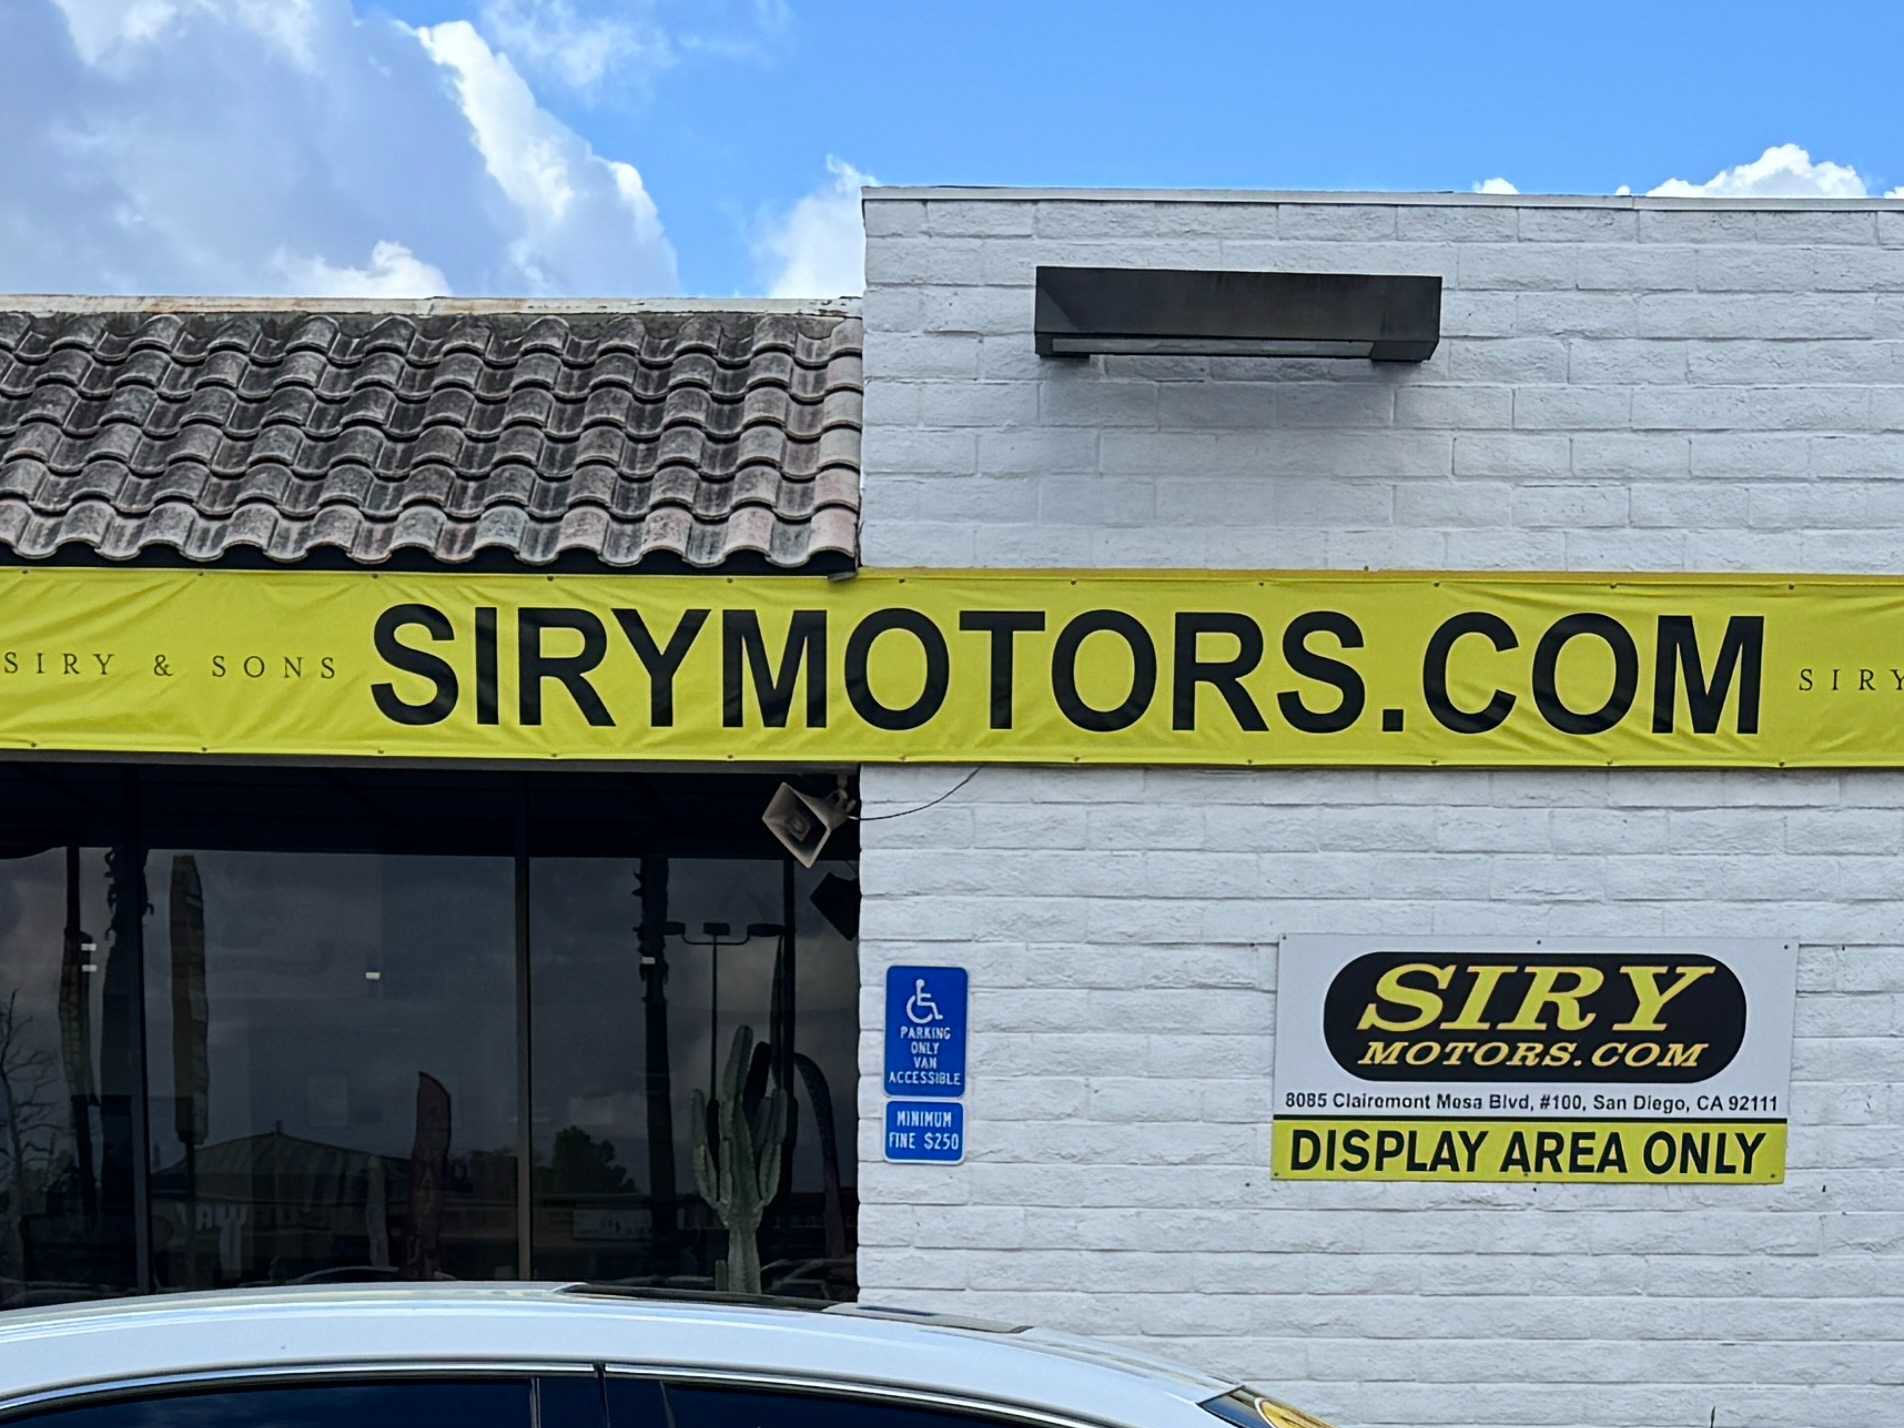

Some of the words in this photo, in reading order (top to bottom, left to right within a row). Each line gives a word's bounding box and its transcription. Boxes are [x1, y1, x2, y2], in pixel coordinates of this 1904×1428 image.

[4, 651, 114, 676] SIRY
[152, 653, 174, 677] &
[211, 655, 338, 680] SONS
[371, 603, 1766, 736] SIRYMOTORS.COM
[1356, 963, 1717, 1033] SIRY
[900, 1026, 951, 1040] PARKING
[911, 1042, 939, 1055] ONLY
[1357, 1041, 1710, 1069] MOTORS.COM
[913, 1057, 937, 1069] VAN
[889, 1071, 961, 1086] ACCESSIBLE
[1285, 1092, 1327, 1108] 8085
[1334, 1092, 1430, 1109] Clairemont
[1437, 1094, 1483, 1109] Mesa
[1489, 1094, 1535, 1111] Blvd,
[1540, 1094, 1587, 1112] #100,
[1593, 1095, 1627, 1111] San
[1633, 1095, 1690, 1114] Diego,
[1697, 1096, 1723, 1111] CA
[1729, 1096, 1777, 1112] 92111
[897, 1111, 952, 1128] MINIMUM
[889, 1133, 916, 1149] FINE
[924, 1133, 959, 1150] $250
[1290, 1129, 1489, 1172] DISPLAY
[1499, 1130, 1628, 1174] AREA
[1643, 1131, 1767, 1175] ONLY
